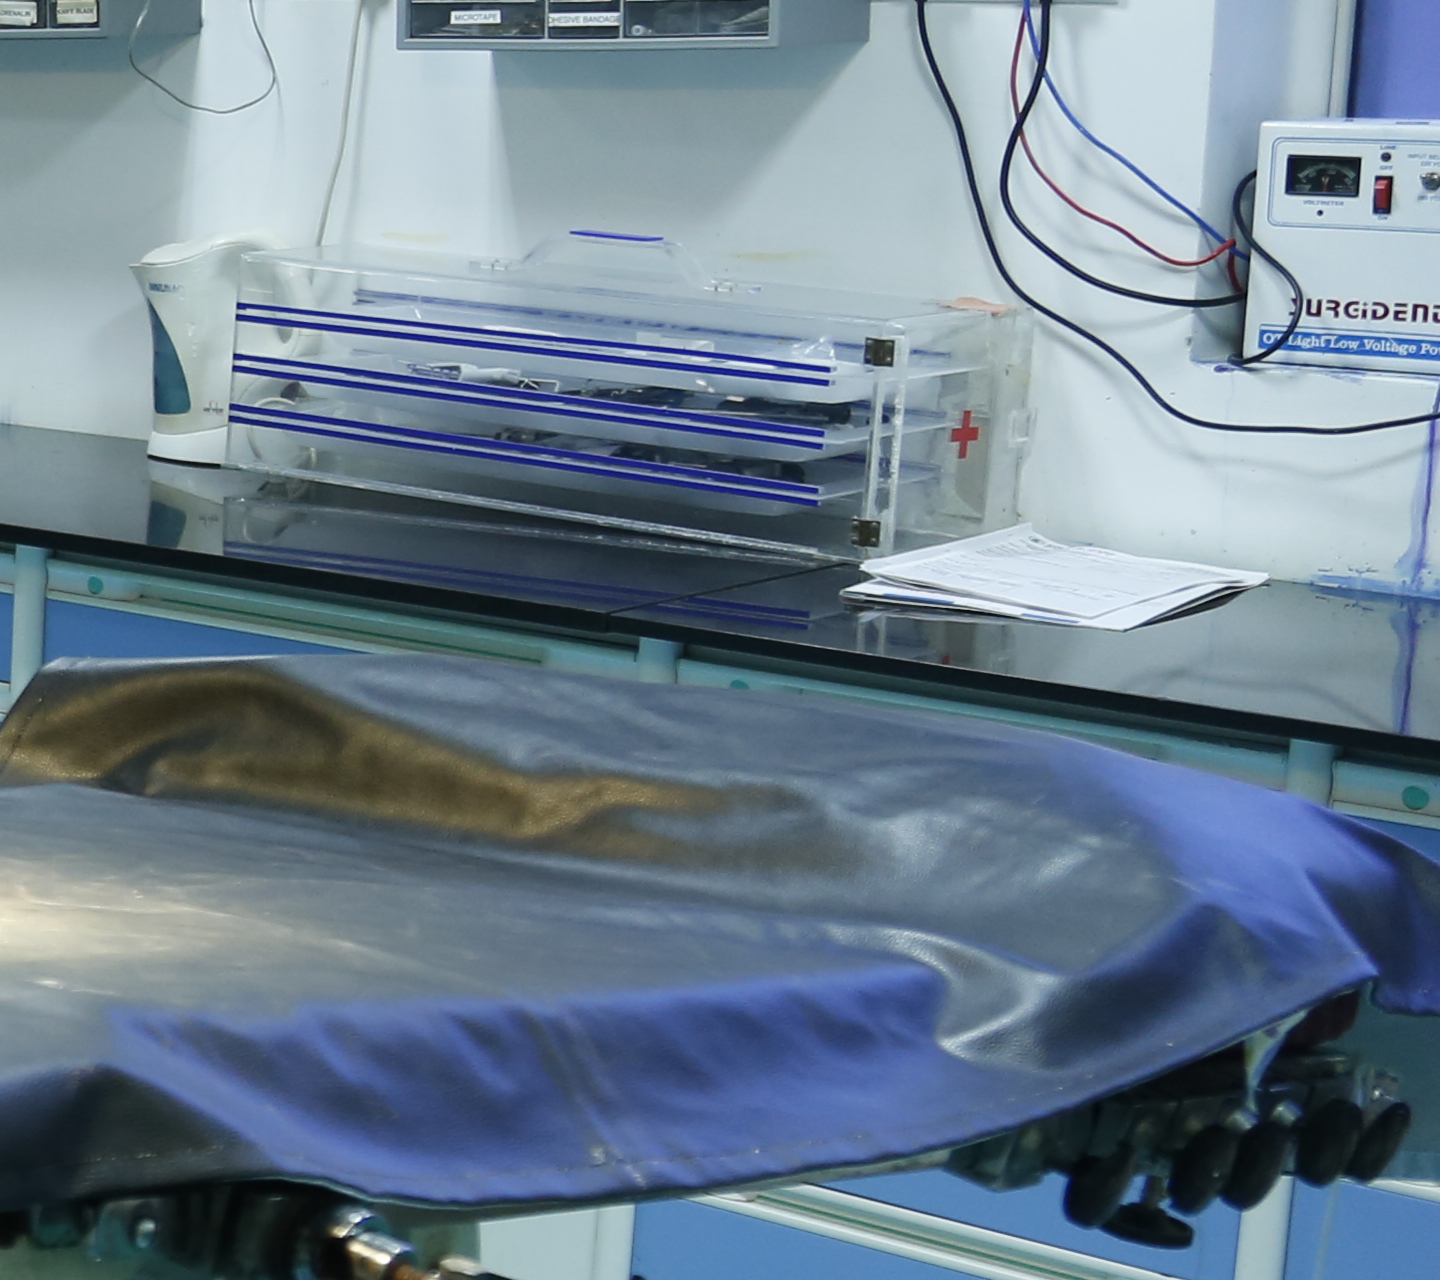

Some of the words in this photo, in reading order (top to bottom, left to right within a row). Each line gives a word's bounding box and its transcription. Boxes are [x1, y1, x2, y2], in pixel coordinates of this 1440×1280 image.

[1288, 334, 1327, 350] Light
[1329, 336, 1360, 350] Low
[1363, 339, 1417, 356] Voltage
[1419, 343, 1440, 356] Po
